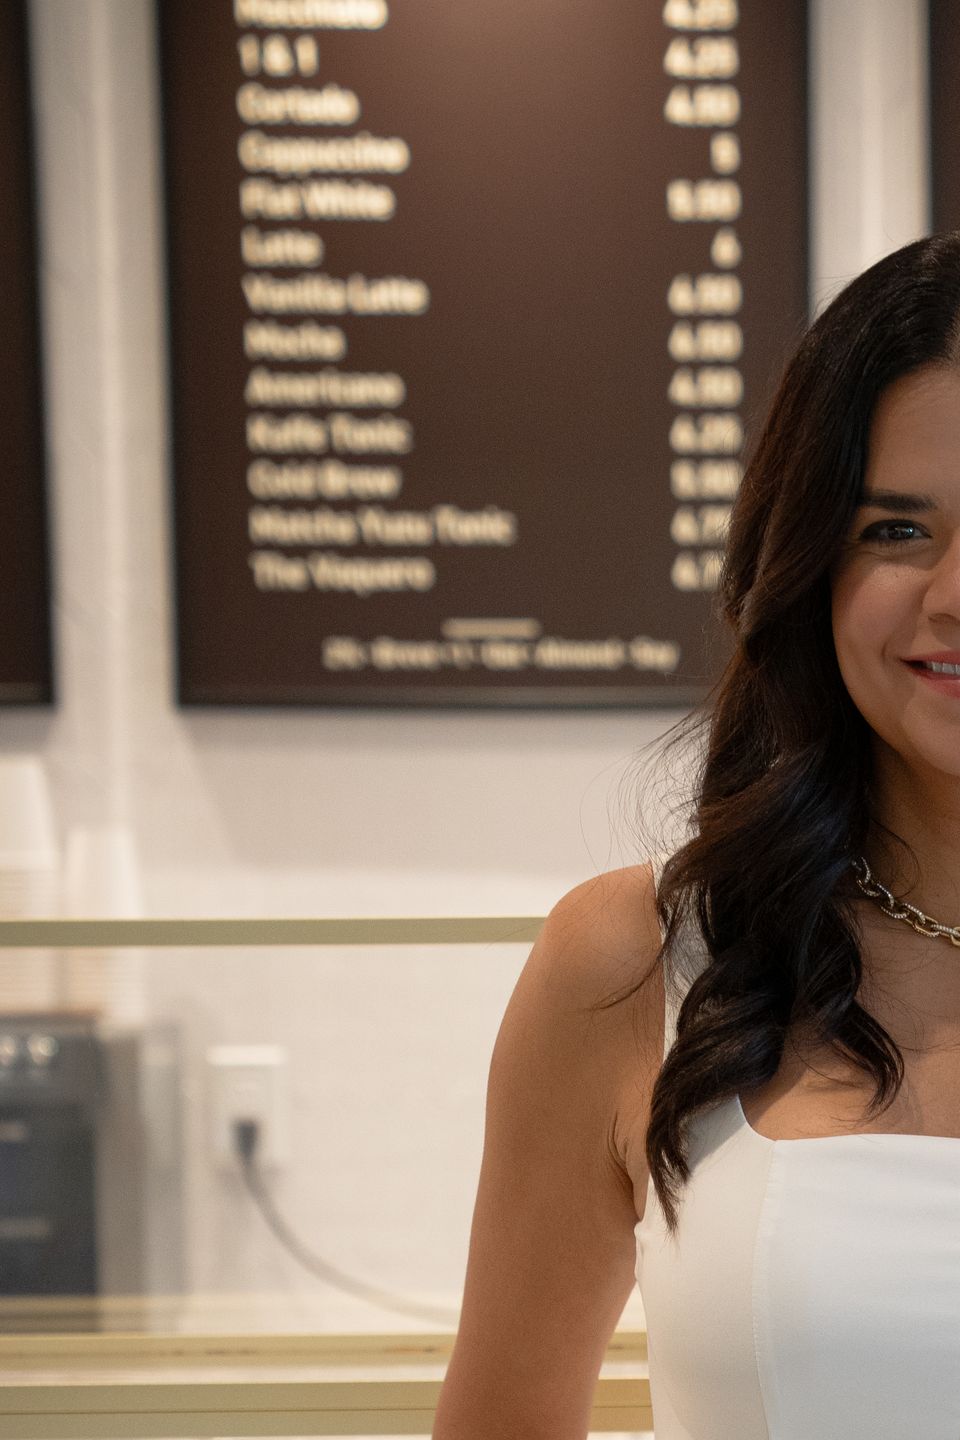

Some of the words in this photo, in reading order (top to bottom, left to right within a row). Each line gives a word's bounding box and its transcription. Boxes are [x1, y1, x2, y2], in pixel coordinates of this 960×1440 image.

[239, 133, 410, 175] Cappuccino
[242, 228, 322, 266] Latte
[348, 276, 428, 313] Latte
[245, 323, 345, 360] Mocha
[246, 370, 405, 406] Americano
